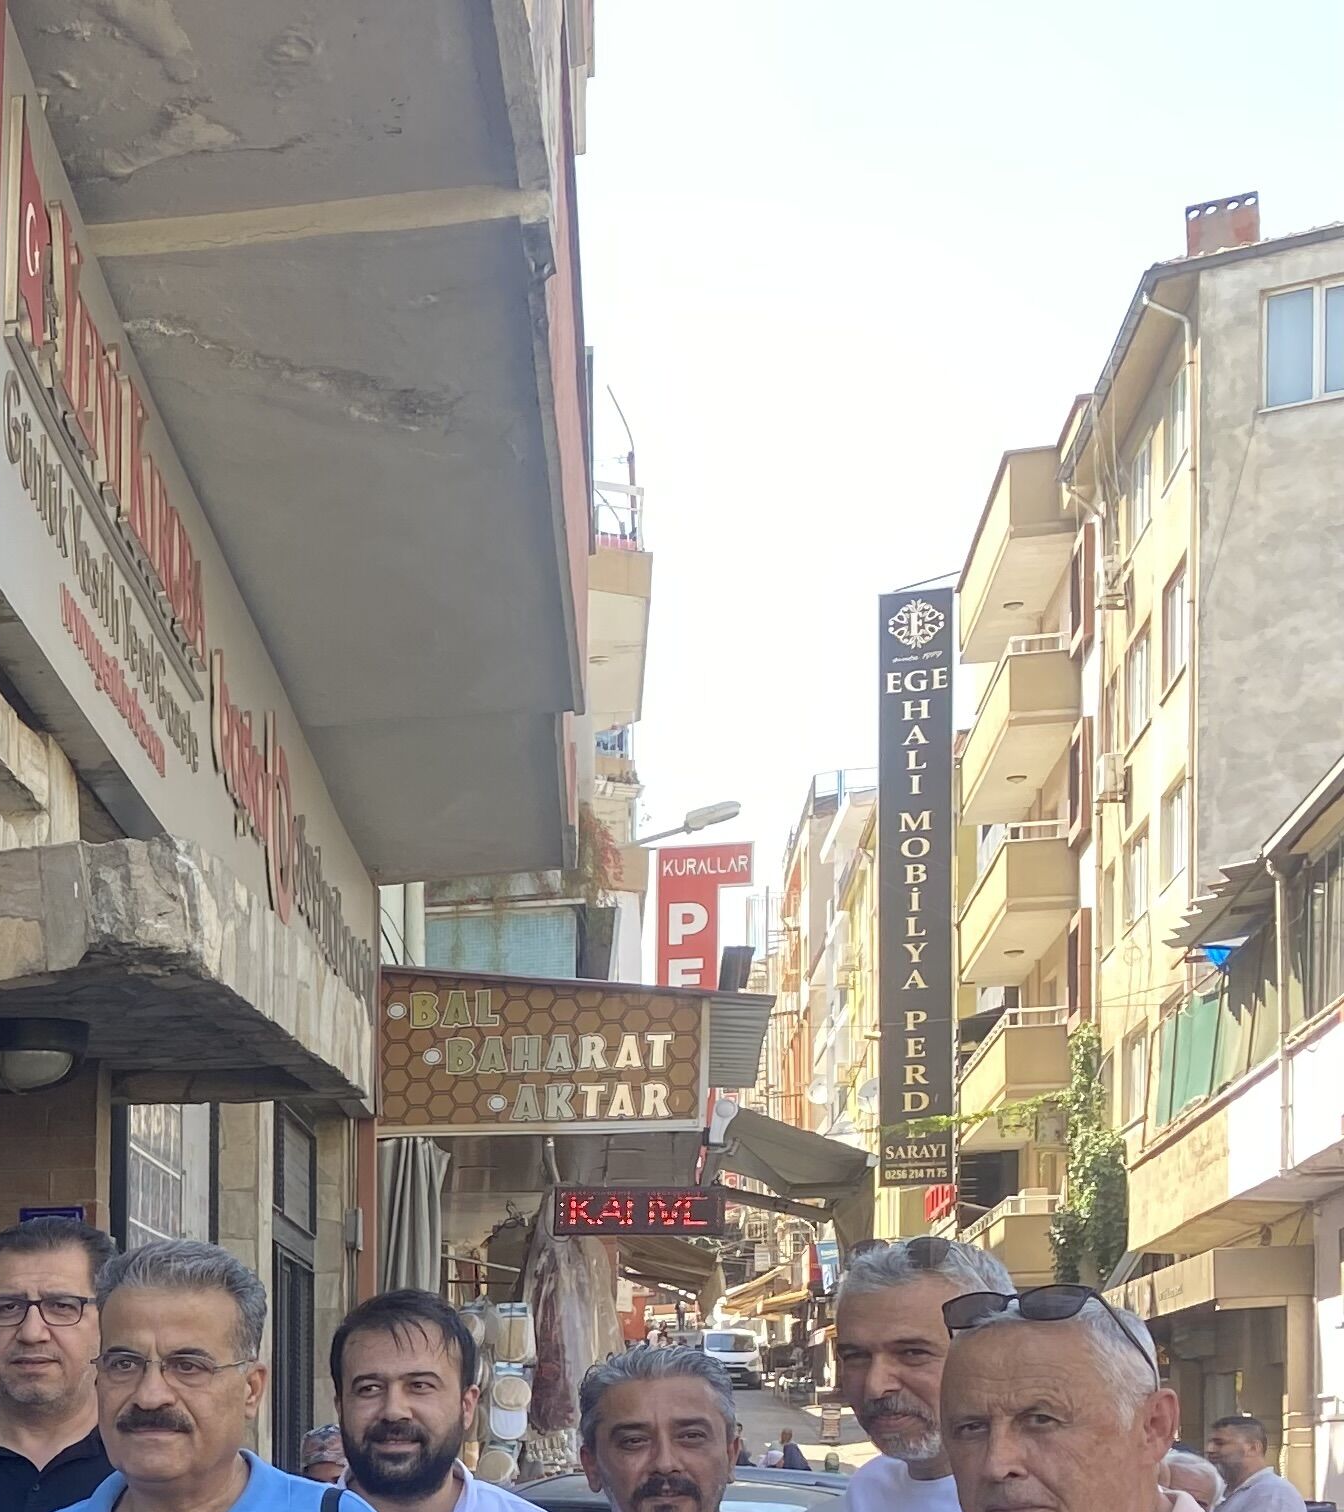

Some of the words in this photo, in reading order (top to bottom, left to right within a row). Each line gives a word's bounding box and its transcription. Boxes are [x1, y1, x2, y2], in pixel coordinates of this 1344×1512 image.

[3, 369, 69, 559] Günlük
[119, 585, 155, 704] Yerel
[886, 667, 948, 694] EGE
[901, 698, 931, 795] HALI
[662, 855, 749, 877] KURALLAR
[899, 810, 933, 990] MOBİLYA
[409, 989, 500, 1029] BAL
[445, 1031, 675, 1075] BAHARAT
[510, 1080, 673, 1121] AKTAR
[885, 1143, 946, 1160] SARAYI
